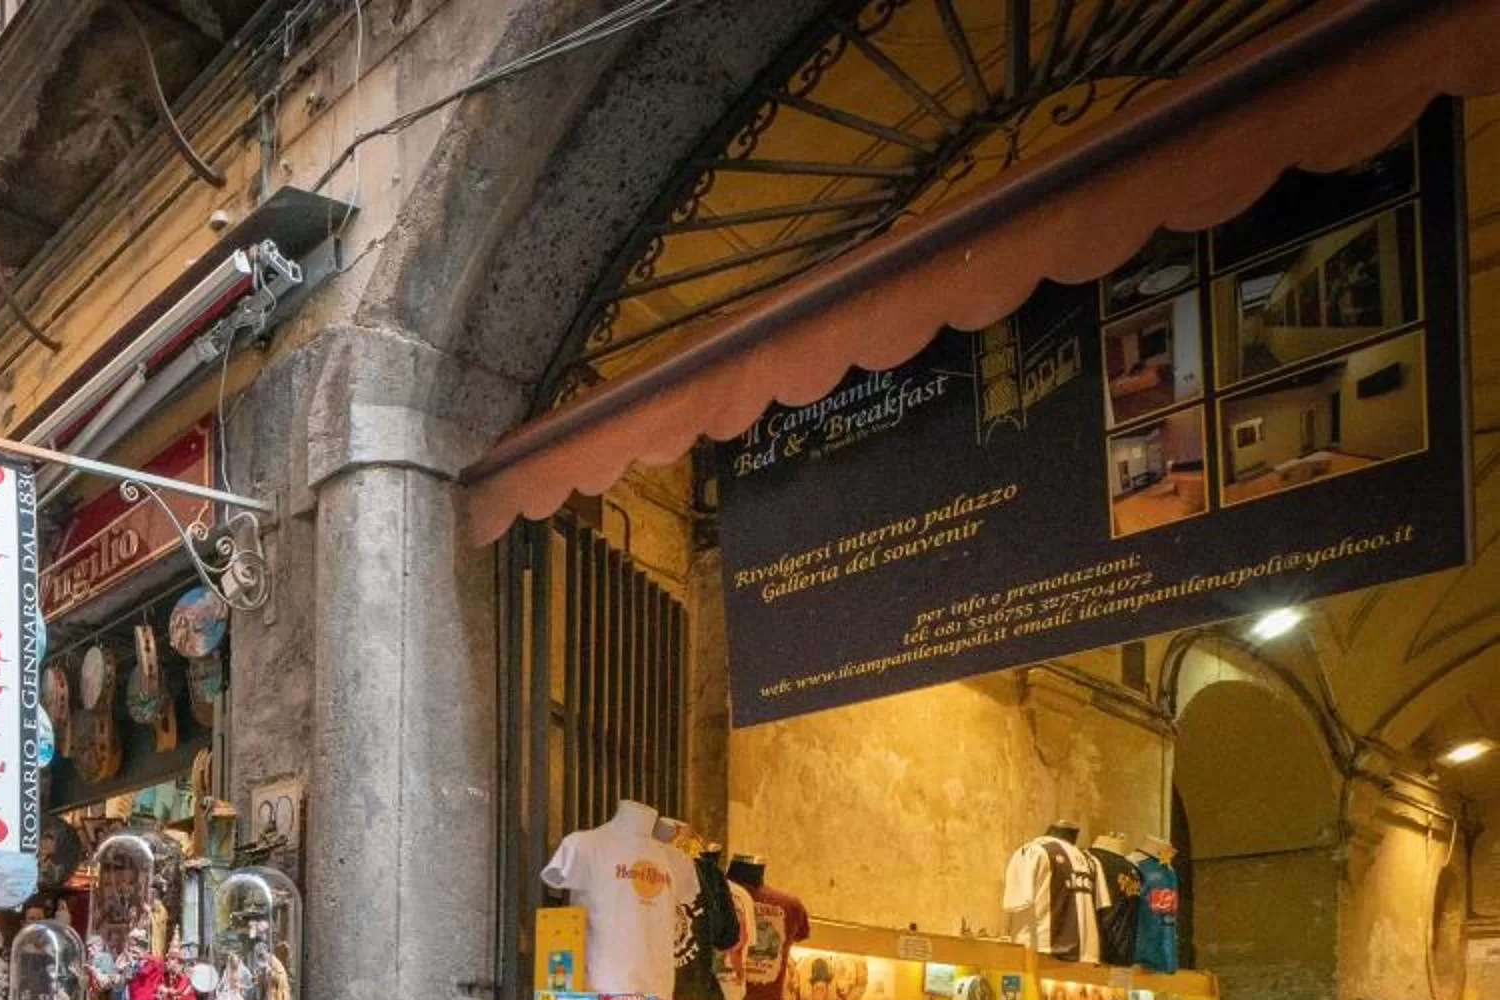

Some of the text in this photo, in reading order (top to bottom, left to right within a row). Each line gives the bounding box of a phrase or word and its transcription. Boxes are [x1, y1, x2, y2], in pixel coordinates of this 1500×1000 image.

[733, 437, 779, 477] Bed
[783, 427, 809, 457] &
[821, 374, 949, 441] Breakfast
[767, 370, 893, 438] Campanile
[21, 526, 37, 574] DAL
[734, 484, 1018, 588] Rivolgersi interno palazzo
[761, 519, 985, 603] Galleria del souvenir
[797, 627, 1008, 690] www.ilcampanilenapoli.it
[1013, 612, 1073, 636] email:
[1079, 523, 1415, 621] ilcampanilenapoli@yahoo.it
[915, 552, 1142, 628] per info e prenotazioni:
[934, 620, 961, 637] 081
[968, 603, 1034, 629] 5516755
[21, 582, 37, 709] GENNARO
[24, 717, 37, 730] E
[21, 737, 37, 849] ROSARIO
